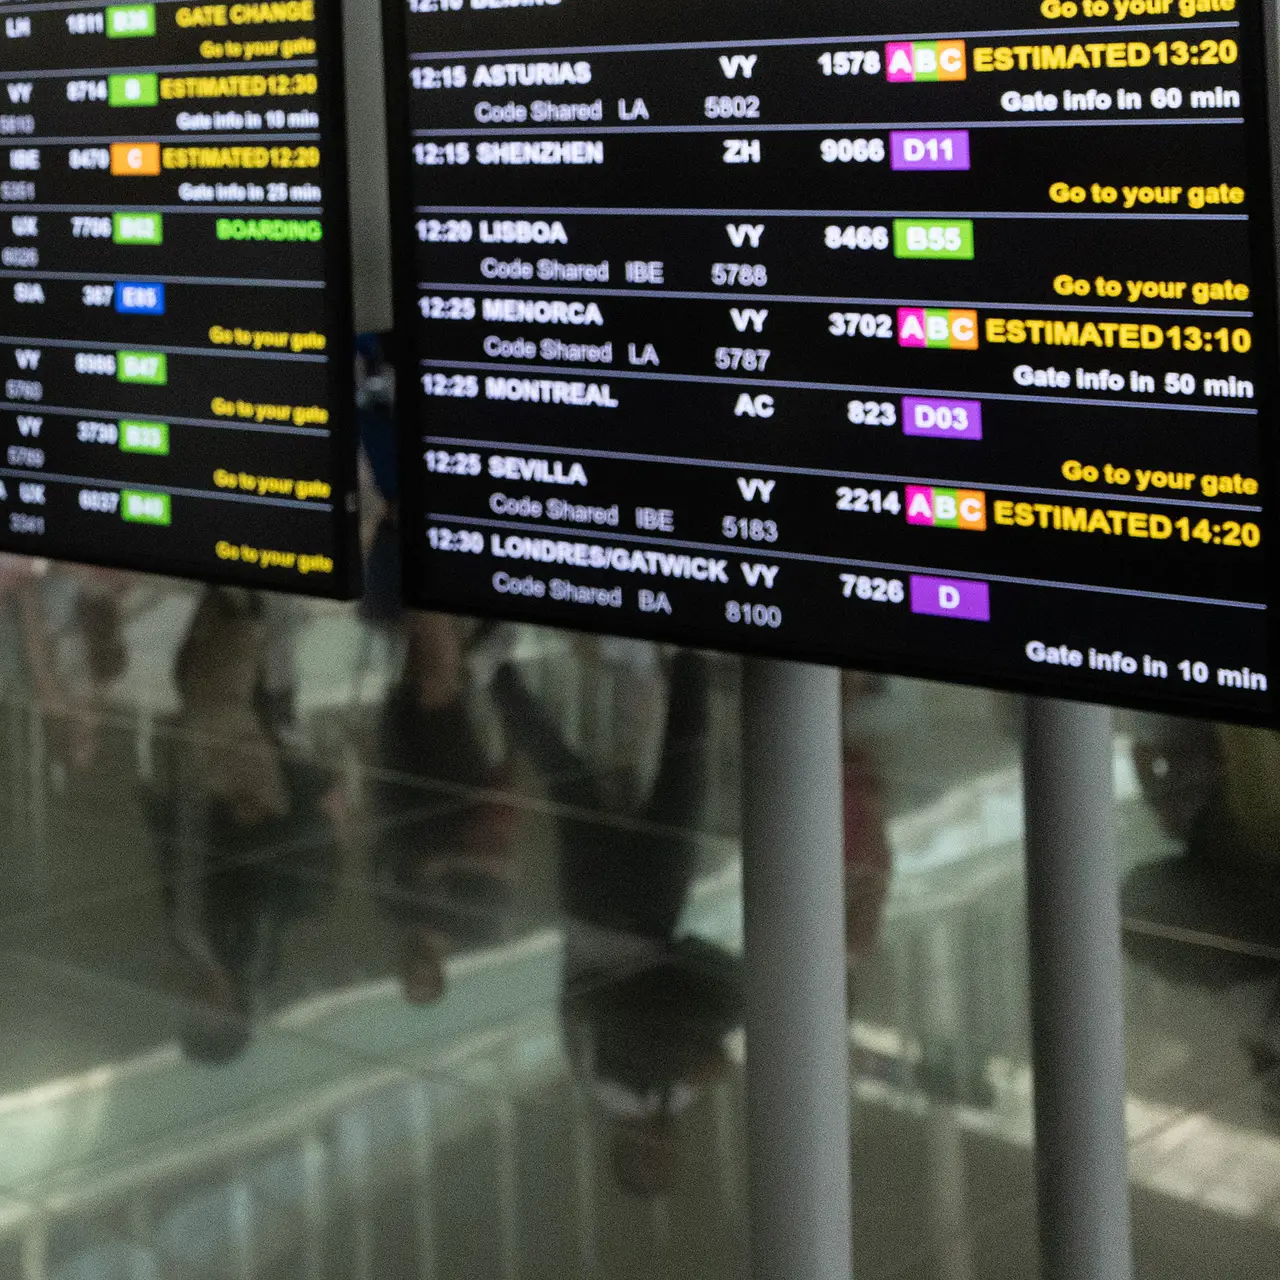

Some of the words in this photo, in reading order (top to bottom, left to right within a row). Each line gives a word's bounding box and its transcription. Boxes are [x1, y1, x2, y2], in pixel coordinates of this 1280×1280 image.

[176, 4, 228, 28] GATE
[229, 0, 315, 25] CHANGE
[200, 40, 224, 59] Go
[242, 39, 279, 60] your
[280, 37, 316, 59] gate
[472, 61, 591, 88] ASTURIAS
[719, 54, 758, 80] VY
[817, 50, 881, 77] 1578
[973, 42, 1151, 73] ESTIMATED
[1152, 39, 1238, 66] 13:20
[475, 141, 604, 165] SHENZHEN
[722, 139, 761, 164] ZH
[820, 138, 885, 163] 9066
[902, 138, 954, 162] D11
[479, 220, 569, 245] LISBOA
[726, 223, 765, 249] VY
[824, 225, 890, 251] 8466
[481, 298, 604, 326] MENORCA
[729, 307, 769, 333] VY
[828, 312, 893, 339] 3702
[985, 317, 1164, 351] ESTIMATED
[1165, 324, 1252, 354] 13:10
[484, 376, 620, 408] MONTREAL
[734, 393, 775, 418] AC
[847, 400, 897, 427] 823
[914, 404, 969, 431] D03
[487, 455, 588, 487] SEVILLA
[737, 476, 776, 503] VY
[836, 486, 901, 515] 2214
[993, 499, 1173, 540] ESTIMATED
[1175, 516, 1261, 548] 14:20
[490, 533, 730, 584] LONDRES/GATWICK
[740, 562, 780, 589] VY
[840, 573, 905, 603] 7826
[939, 585, 960, 609] D
